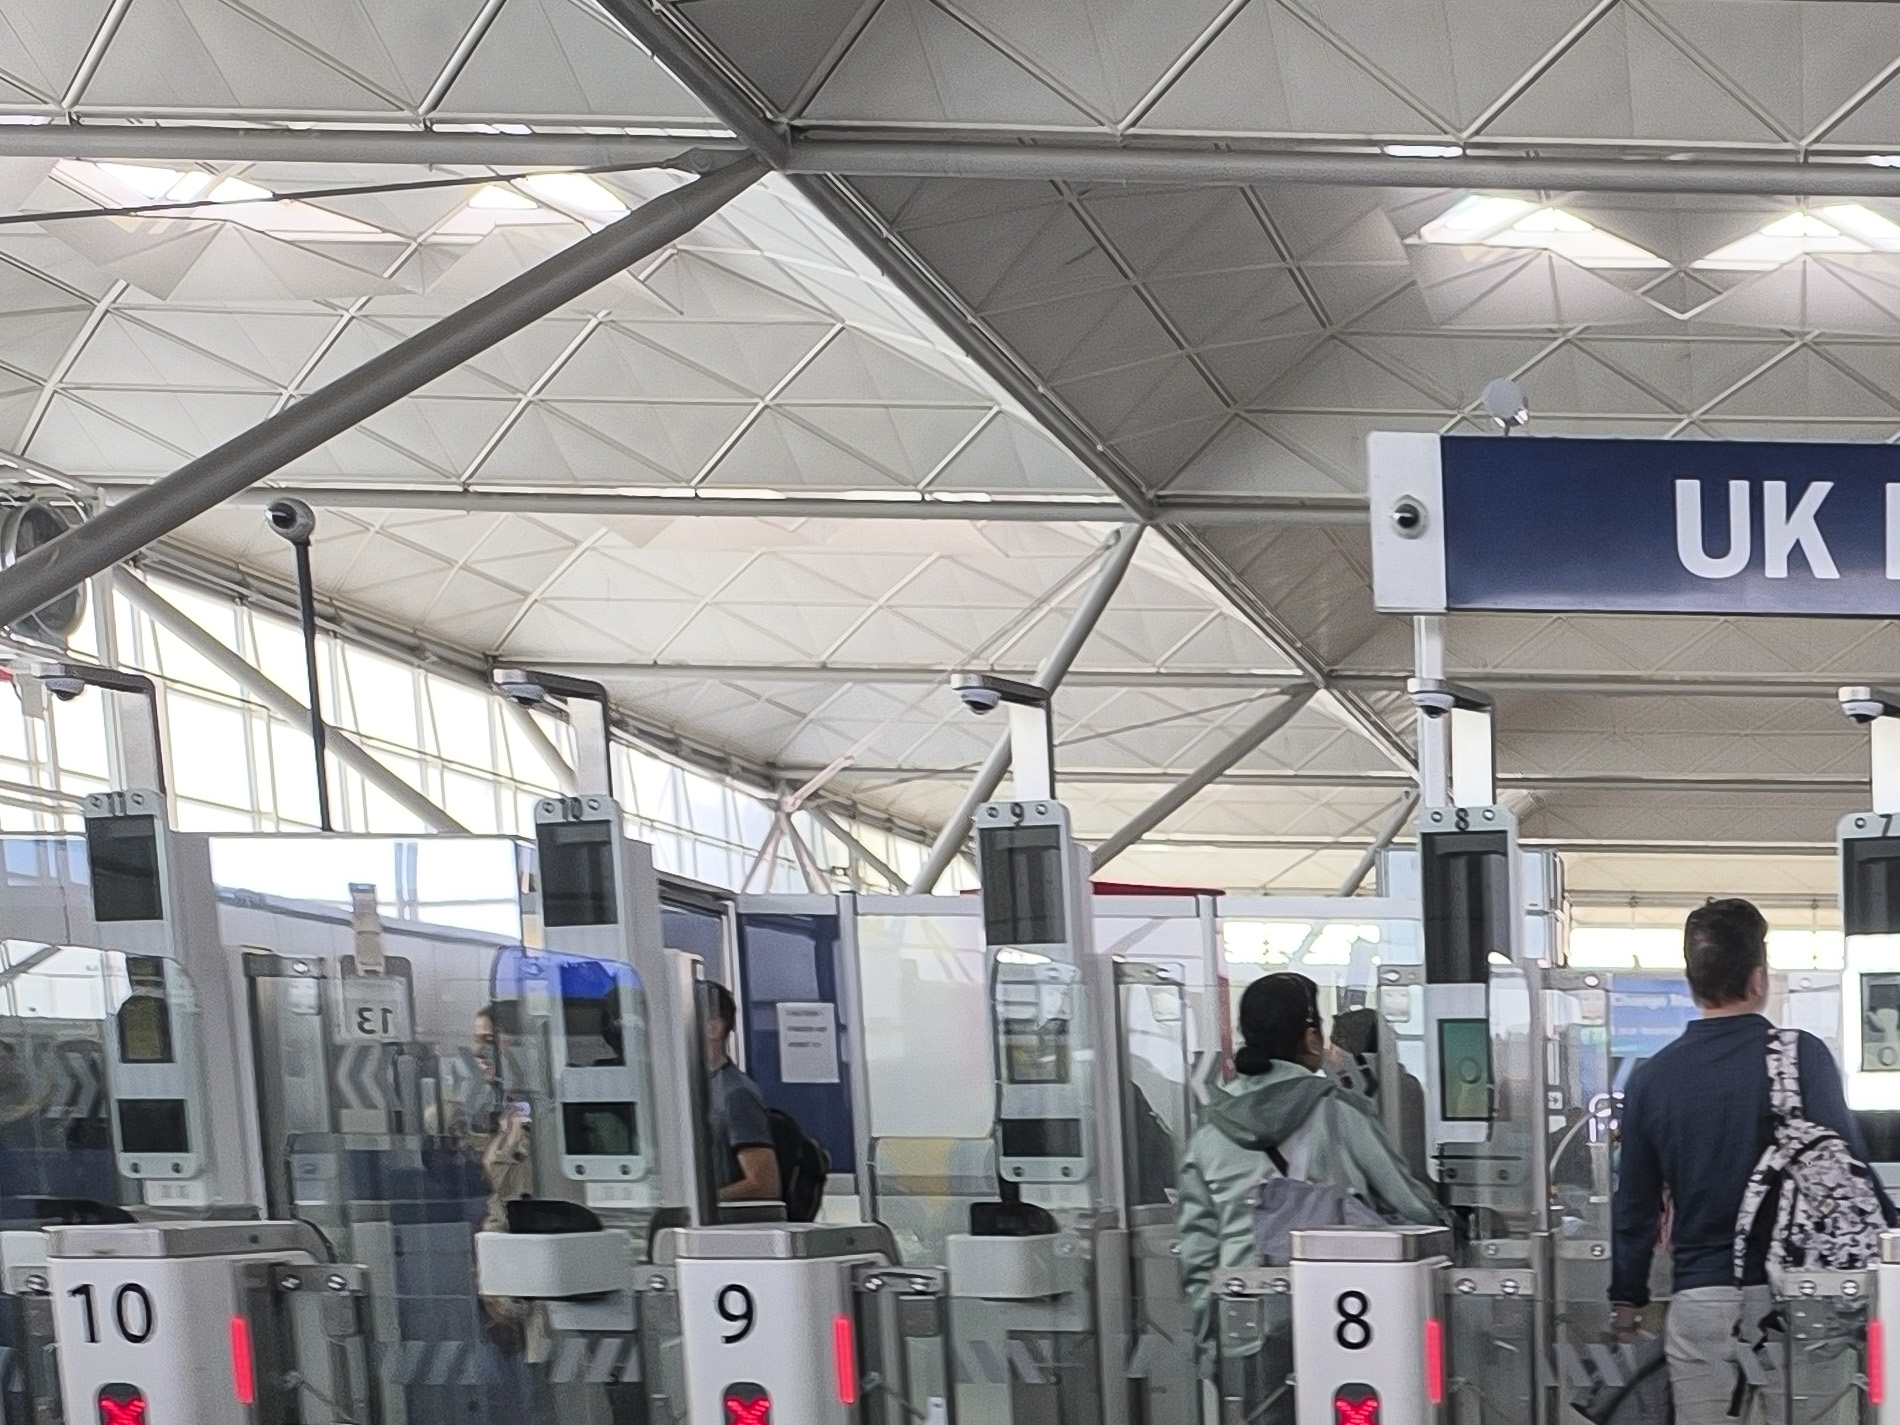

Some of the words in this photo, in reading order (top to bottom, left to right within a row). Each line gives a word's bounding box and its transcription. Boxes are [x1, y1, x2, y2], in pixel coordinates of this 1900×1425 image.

[1673, 478, 1842, 581] UK
[560, 797, 583, 821] 10
[1010, 802, 1025, 825] 9
[1454, 807, 1470, 832] 8
[1878, 813, 1893, 838] 7
[67, 1281, 154, 1345] 10
[716, 1282, 755, 1345] 9
[1334, 1289, 1373, 1351] 8
